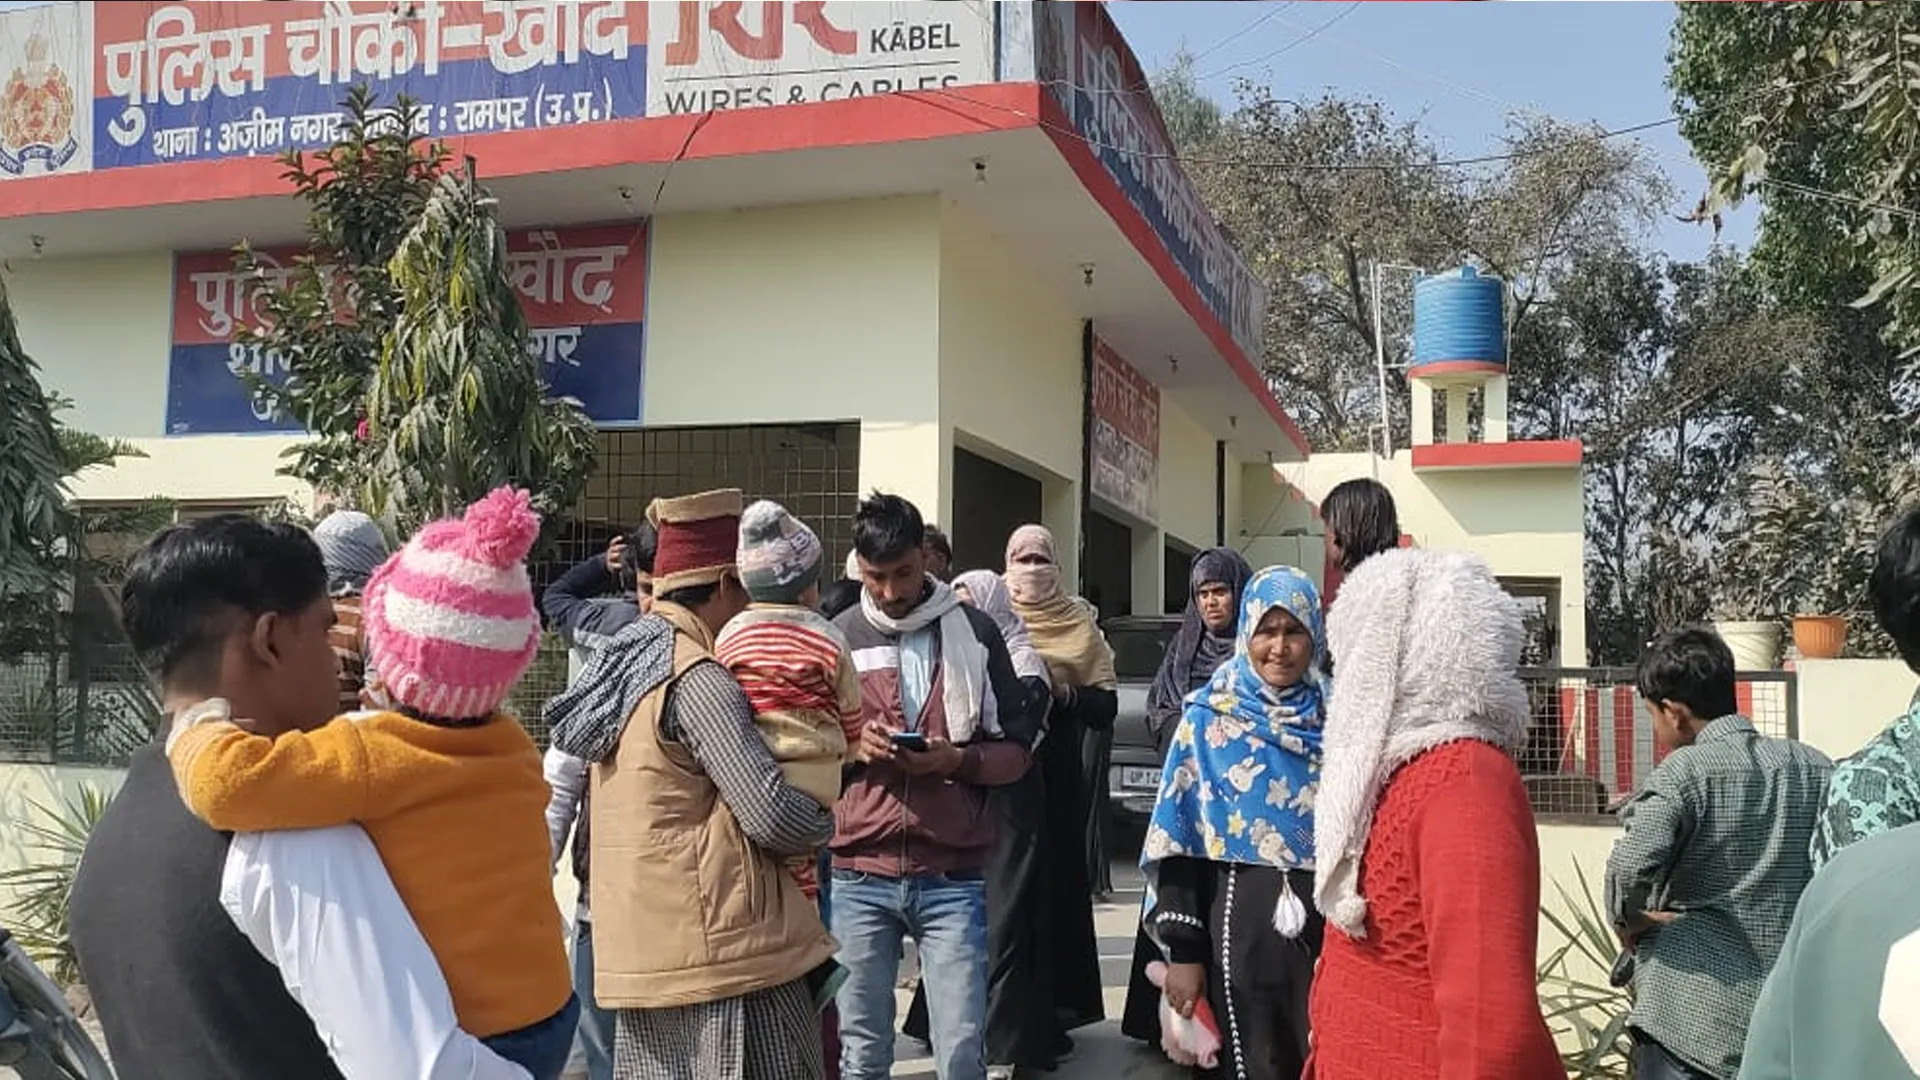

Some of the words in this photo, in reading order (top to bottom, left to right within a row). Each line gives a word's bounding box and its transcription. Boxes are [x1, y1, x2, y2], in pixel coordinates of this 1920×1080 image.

[104, 5, 271, 146] पुलिस
[665, 87, 773, 115] WIRES
[787, 85, 806, 104] &
[153, 126, 199, 157] थाना
[526, 327, 582, 367] गर
